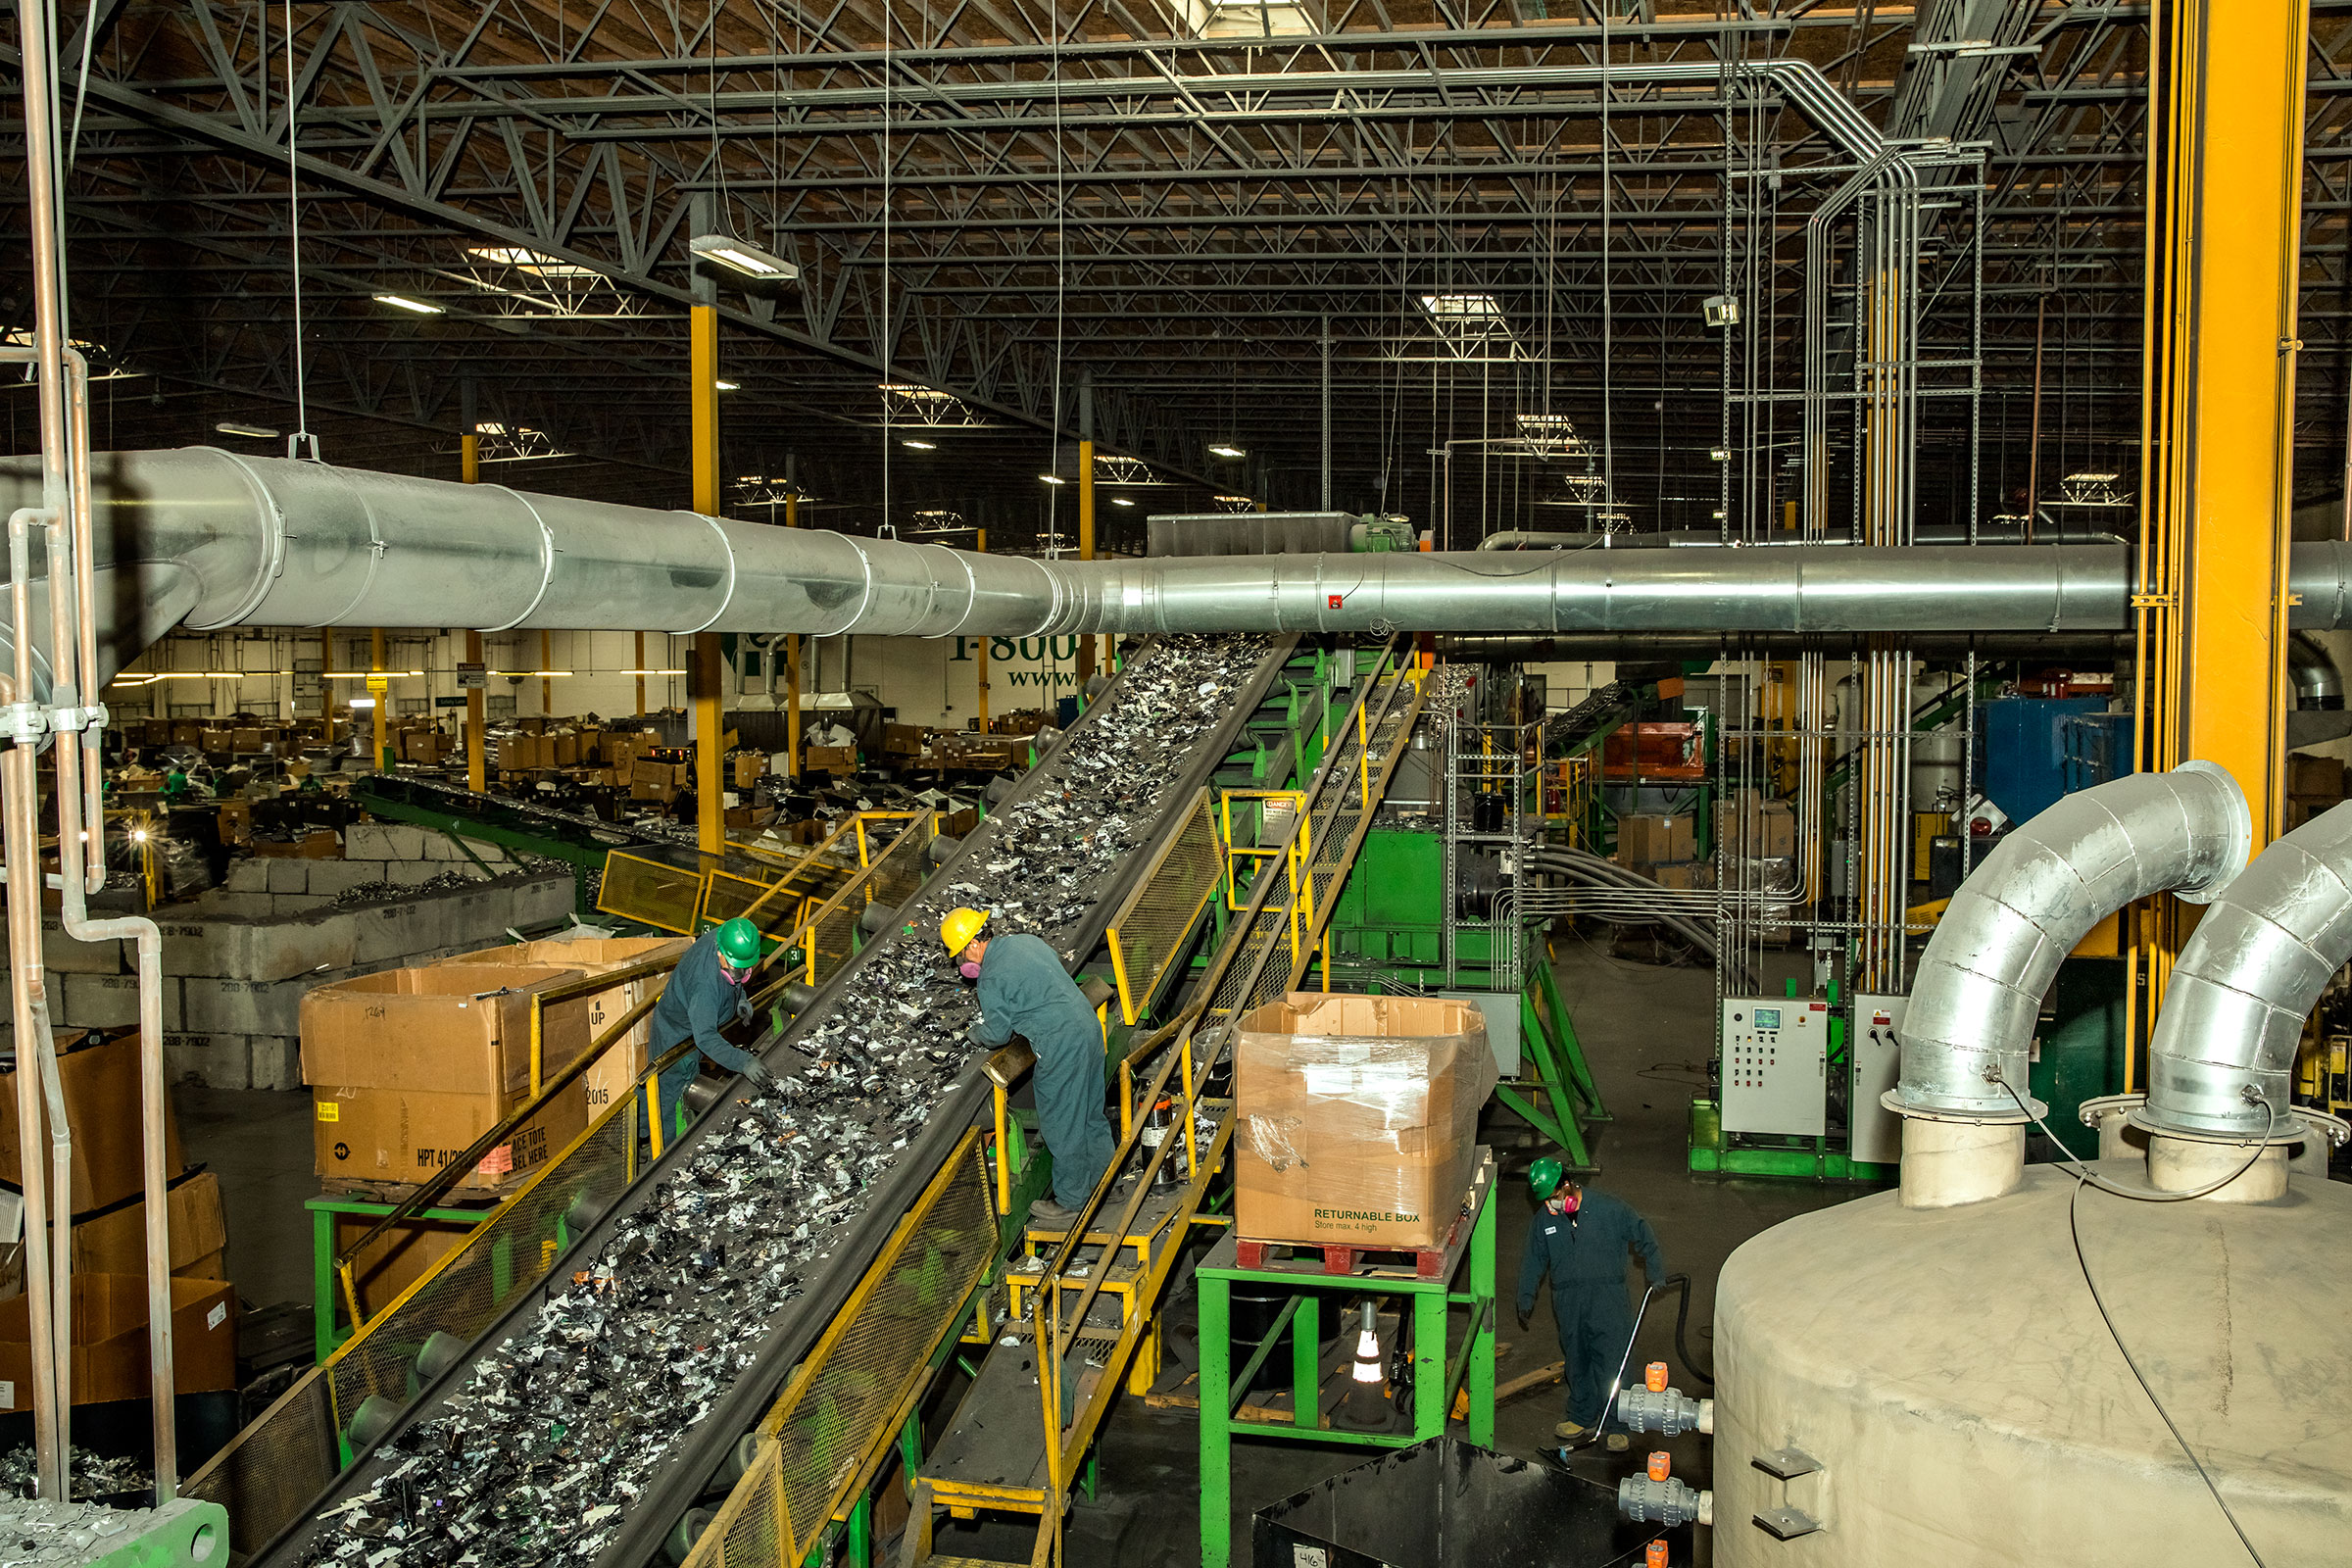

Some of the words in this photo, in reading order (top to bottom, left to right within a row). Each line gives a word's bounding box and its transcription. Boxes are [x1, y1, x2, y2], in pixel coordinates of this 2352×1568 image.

[591, 1011, 606, 1026] UP
[527, 1126, 547, 1147] TOTE
[417, 1149, 435, 1167] HPT
[528, 1144, 549, 1165] HERE
[1314, 1208, 1393, 1222] RETURNABLE
[1395, 1212, 1420, 1223] BOX
[1314, 1220, 1334, 1230] Store
[1336, 1222, 1352, 1231] max.
[1354, 1222, 1360, 1231] 4
[1361, 1223, 1378, 1233] high
[1299, 1552, 1319, 1567] 416
